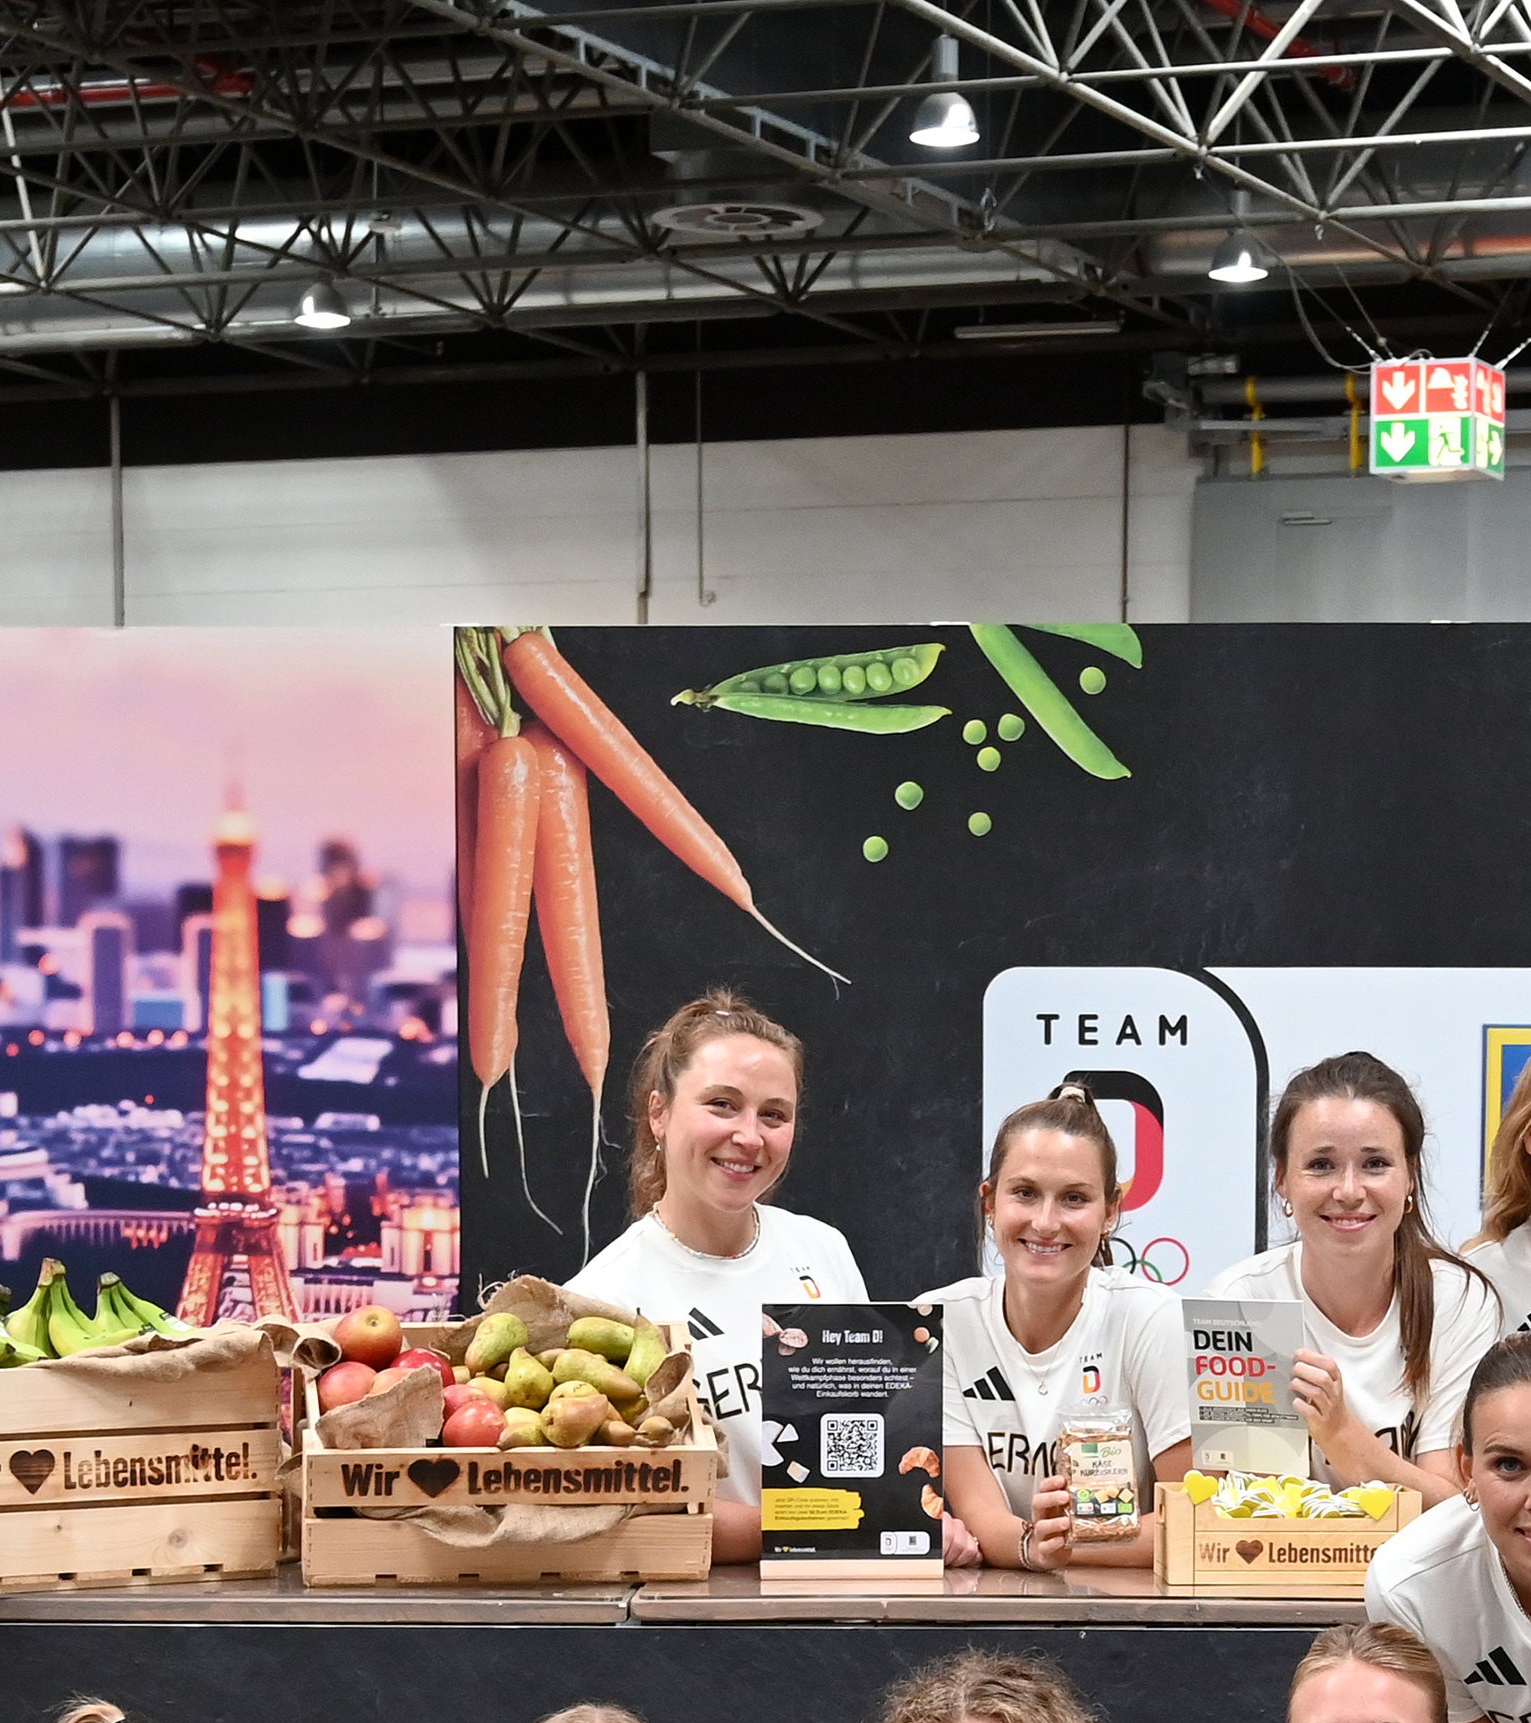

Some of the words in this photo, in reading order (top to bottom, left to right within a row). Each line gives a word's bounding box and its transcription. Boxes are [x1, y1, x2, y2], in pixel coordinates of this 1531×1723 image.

[1036, 1013, 1189, 1046] TEAM
[821, 1330, 842, 1347] Hey
[843, 1330, 870, 1344] Team
[872, 1330, 884, 1344] D!
[1193, 1329, 1253, 1352] DEIN
[1195, 1355, 1276, 1377] FOOD-
[1197, 1381, 1276, 1404] GUIDE
[62, 1441, 258, 1491] Lebensmittel.
[340, 1463, 401, 1497] Wir
[468, 1459, 690, 1494] Lebensmittel.
[1198, 1542, 1233, 1565] Wir
[1268, 1540, 1380, 1565] Lebensmitt
